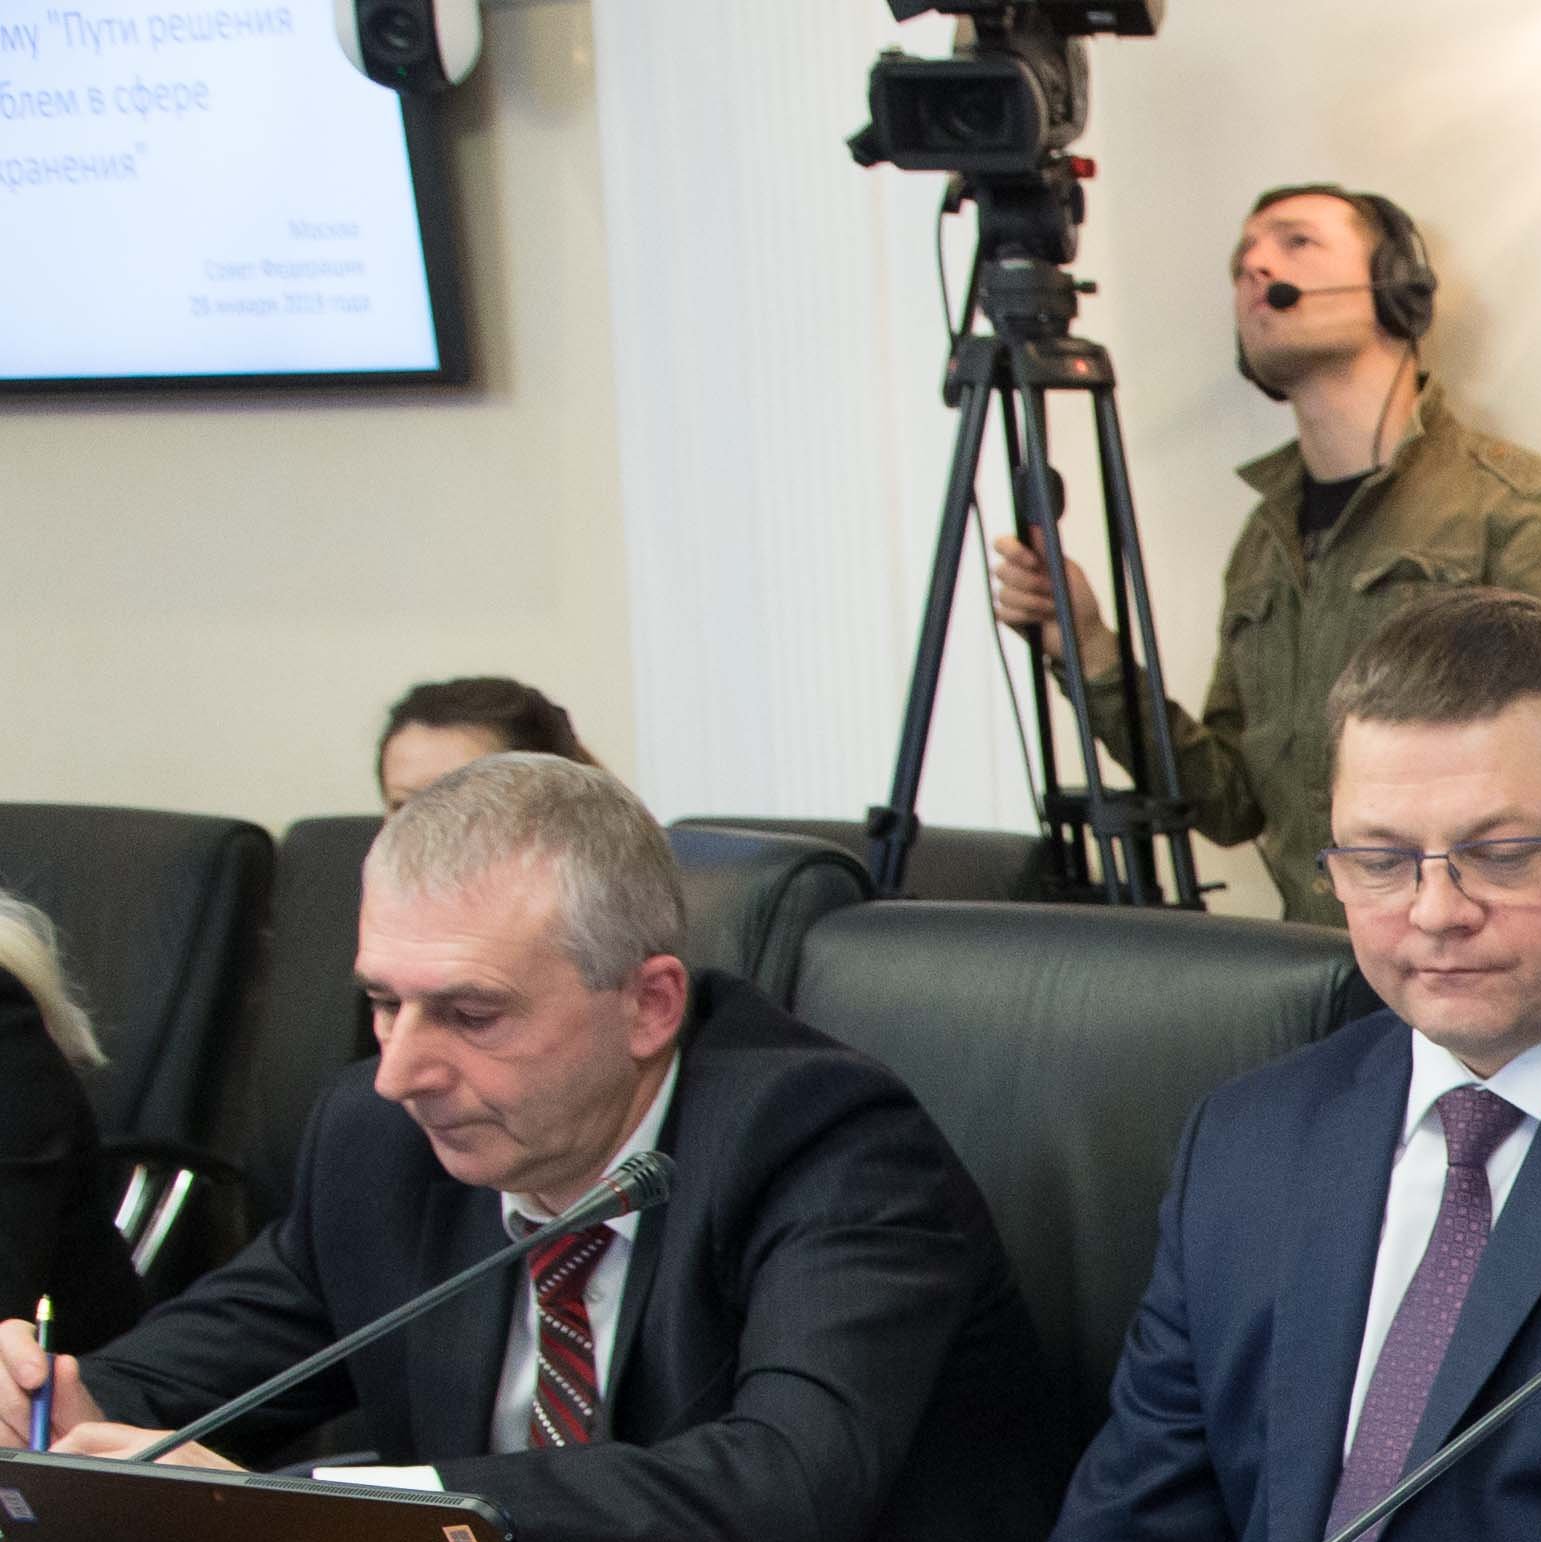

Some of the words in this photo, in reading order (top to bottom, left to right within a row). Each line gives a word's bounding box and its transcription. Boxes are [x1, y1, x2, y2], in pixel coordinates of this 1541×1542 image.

[47, 10, 139, 56] "Пути
[146, 8, 294, 53] решения
[87, 84, 106, 116] в
[112, 74, 211, 122] сфере
